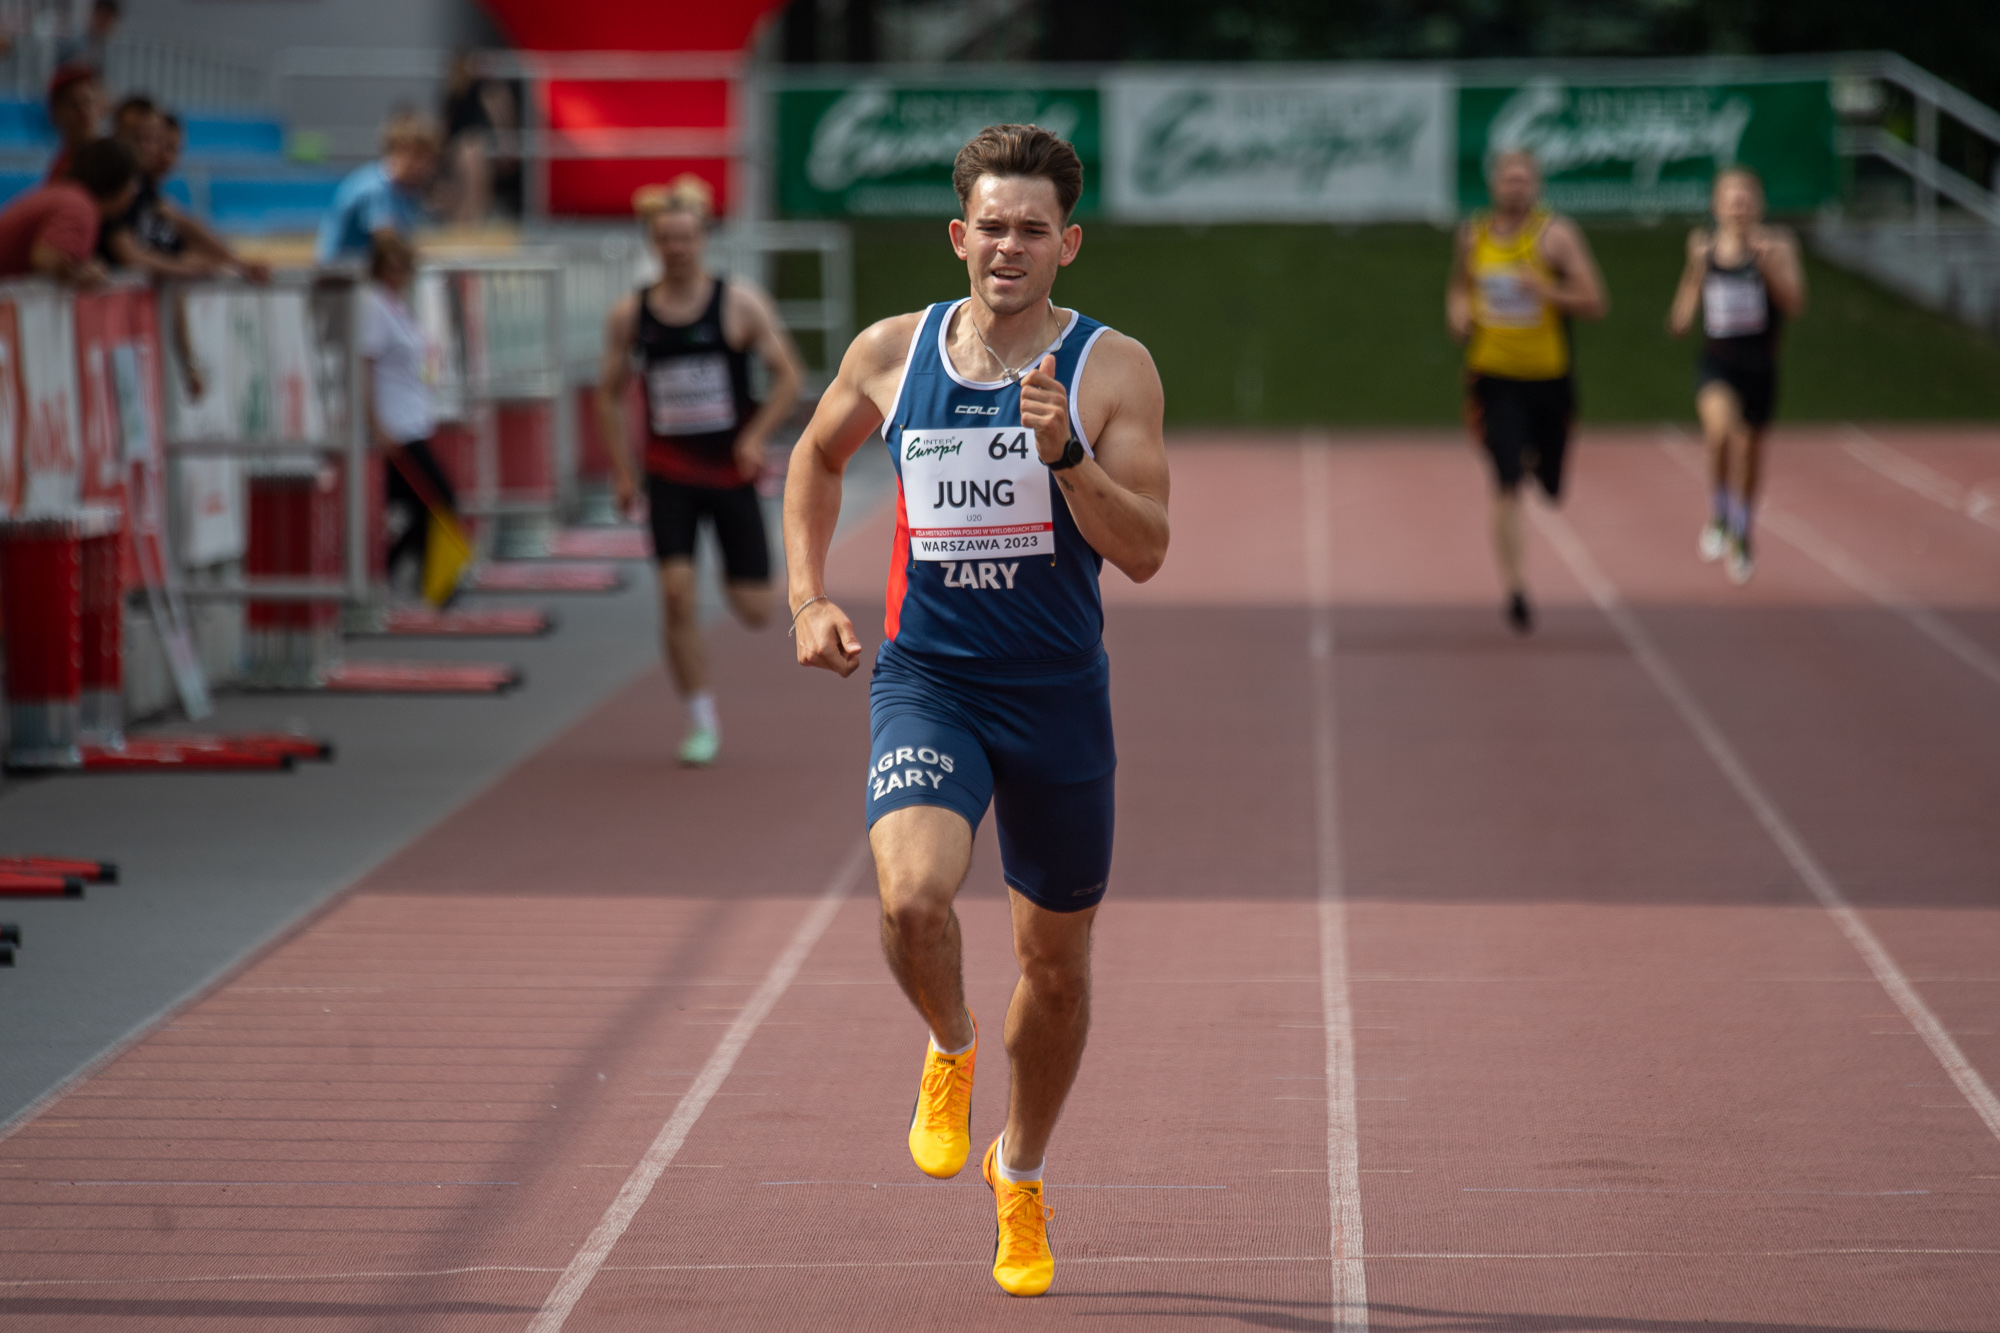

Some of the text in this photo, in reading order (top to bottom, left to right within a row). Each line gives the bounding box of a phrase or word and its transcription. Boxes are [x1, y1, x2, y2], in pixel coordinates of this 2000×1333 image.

[955, 405, 999, 415] COLO
[906, 437, 963, 461] Europol
[988, 432, 1028, 460] 64
[934, 479, 1015, 509] JUNG
[966, 514, 982, 522] U20
[926, 529, 961, 537] MISTRZOSTWA
[962, 528, 981, 536] POLSKI
[1030, 524, 1044, 532] 2023
[921, 535, 1038, 552] WARSZAWA 2023
[868, 747, 954, 787] AGROS
[873, 769, 943, 801] ŻARY
